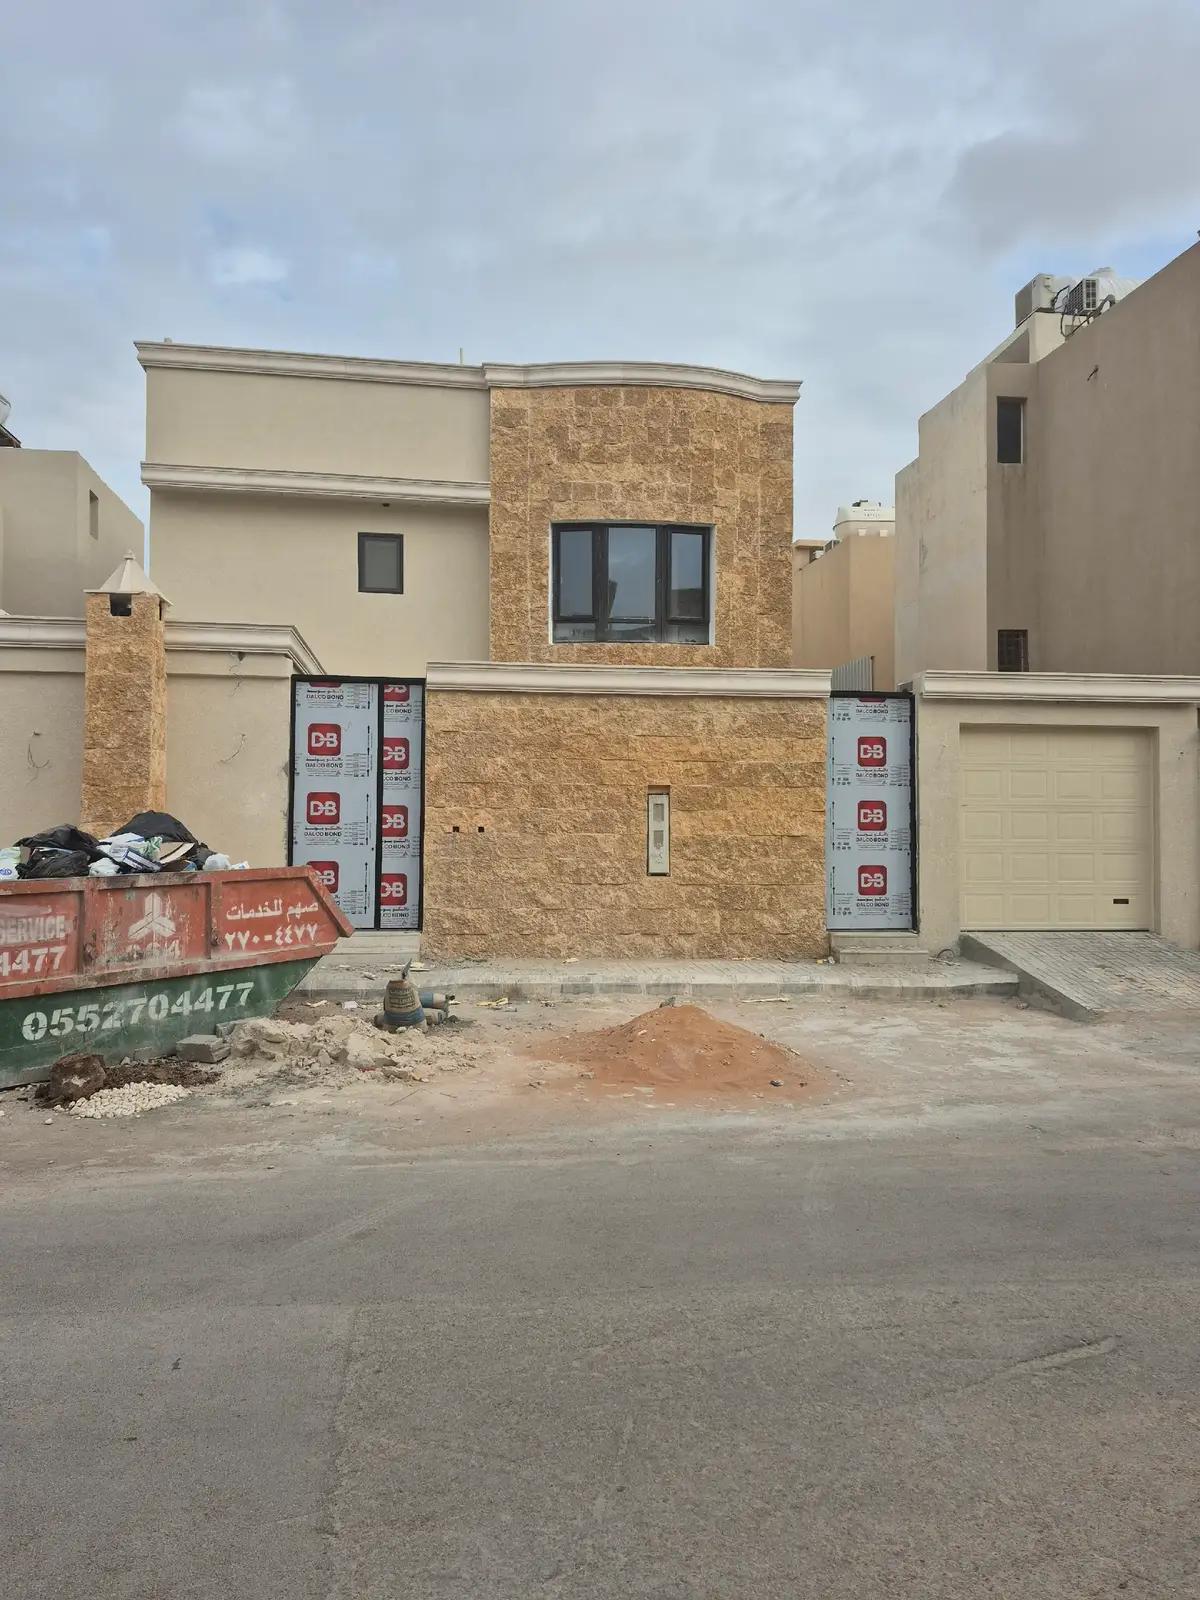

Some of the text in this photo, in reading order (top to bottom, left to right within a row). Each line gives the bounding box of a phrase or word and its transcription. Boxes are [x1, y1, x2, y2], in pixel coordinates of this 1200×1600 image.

[311, 732, 338, 748] DB
[860, 744, 884, 758] DB
[310, 800, 338, 816] DB
[860, 808, 884, 823] DB
[860, 874, 884, 888] DB
[226, 898, 282, 920] للخدمات
[21, 982, 254, 1041] 0552704477
